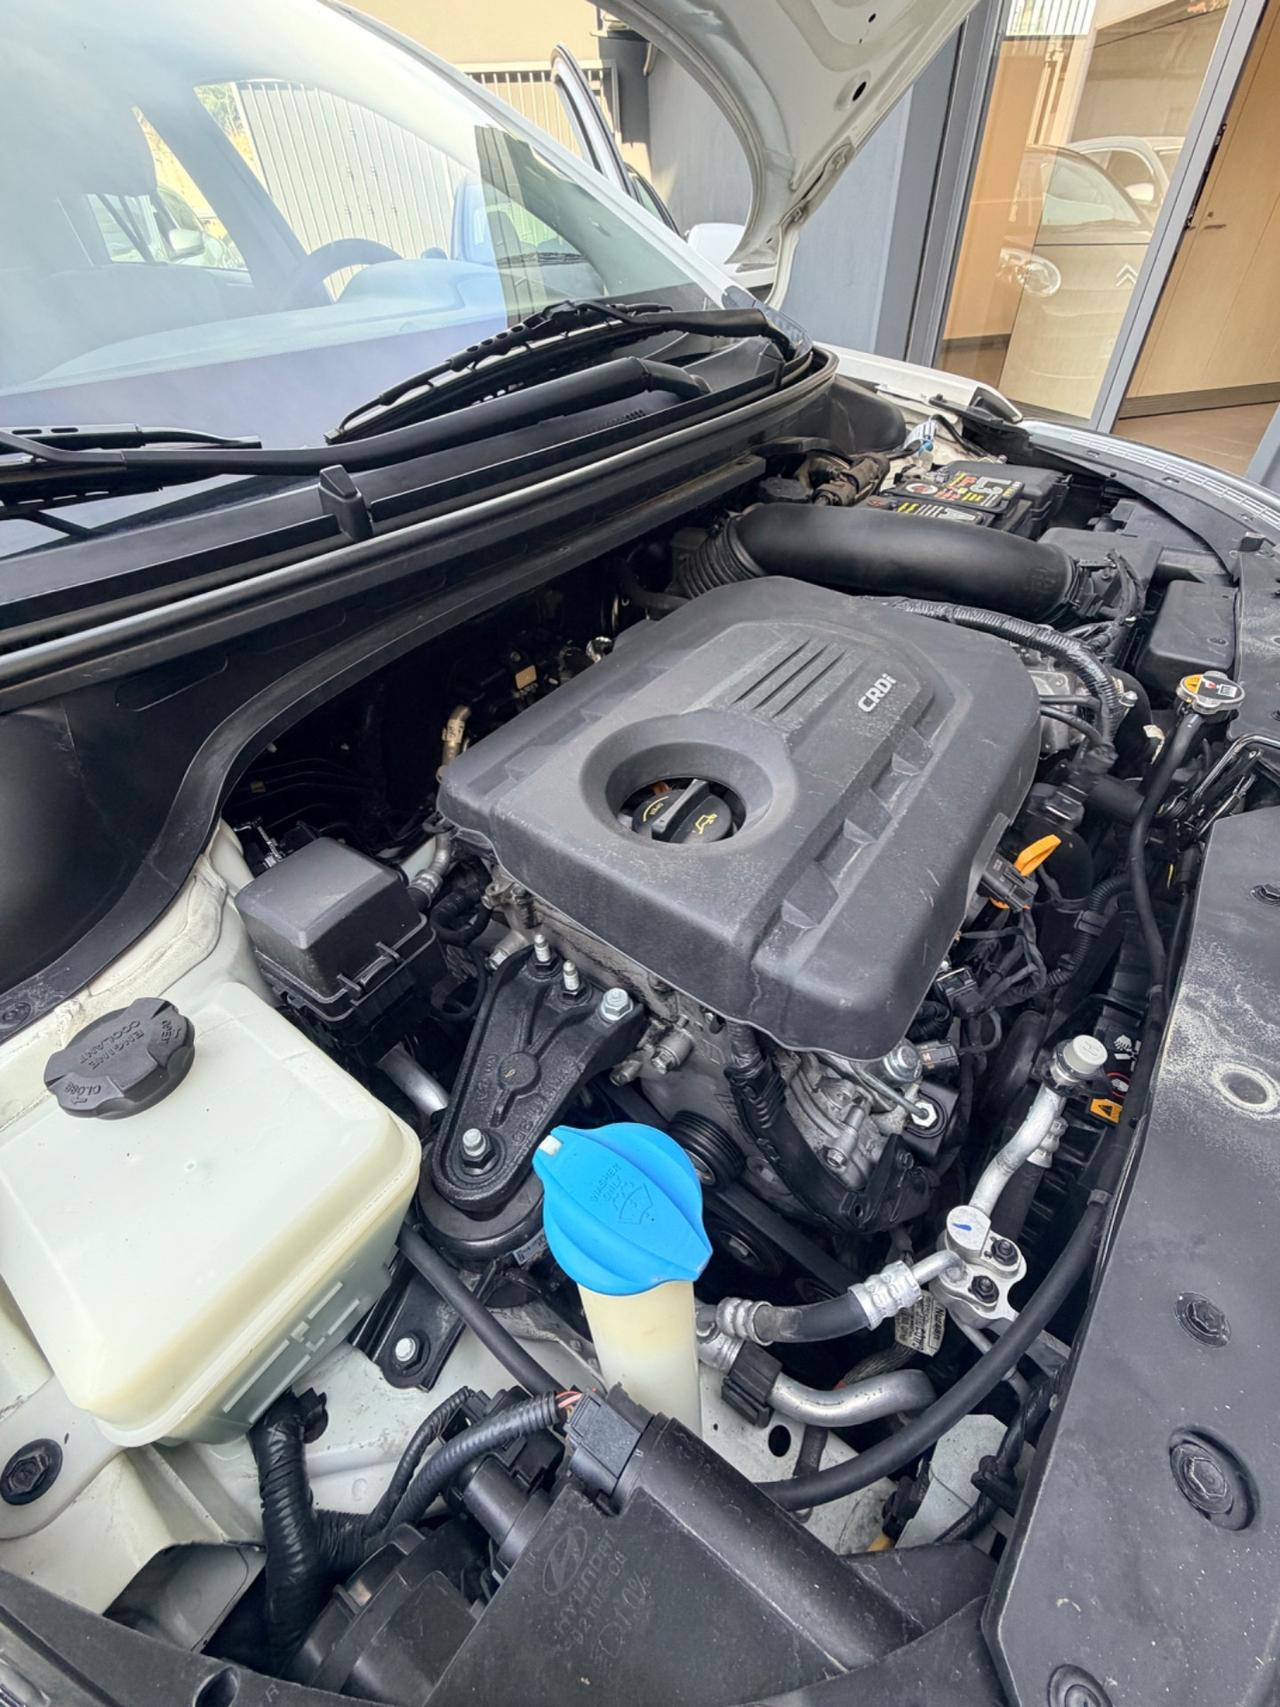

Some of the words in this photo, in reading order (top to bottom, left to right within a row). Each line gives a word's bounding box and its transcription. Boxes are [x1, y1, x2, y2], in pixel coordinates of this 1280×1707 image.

[858, 672, 897, 712] CRDi
[80, 1019, 141, 1064] COOLANT
[88, 1028, 145, 1070] ENGINE
[555, 1529, 616, 1634] HYUNDAI
